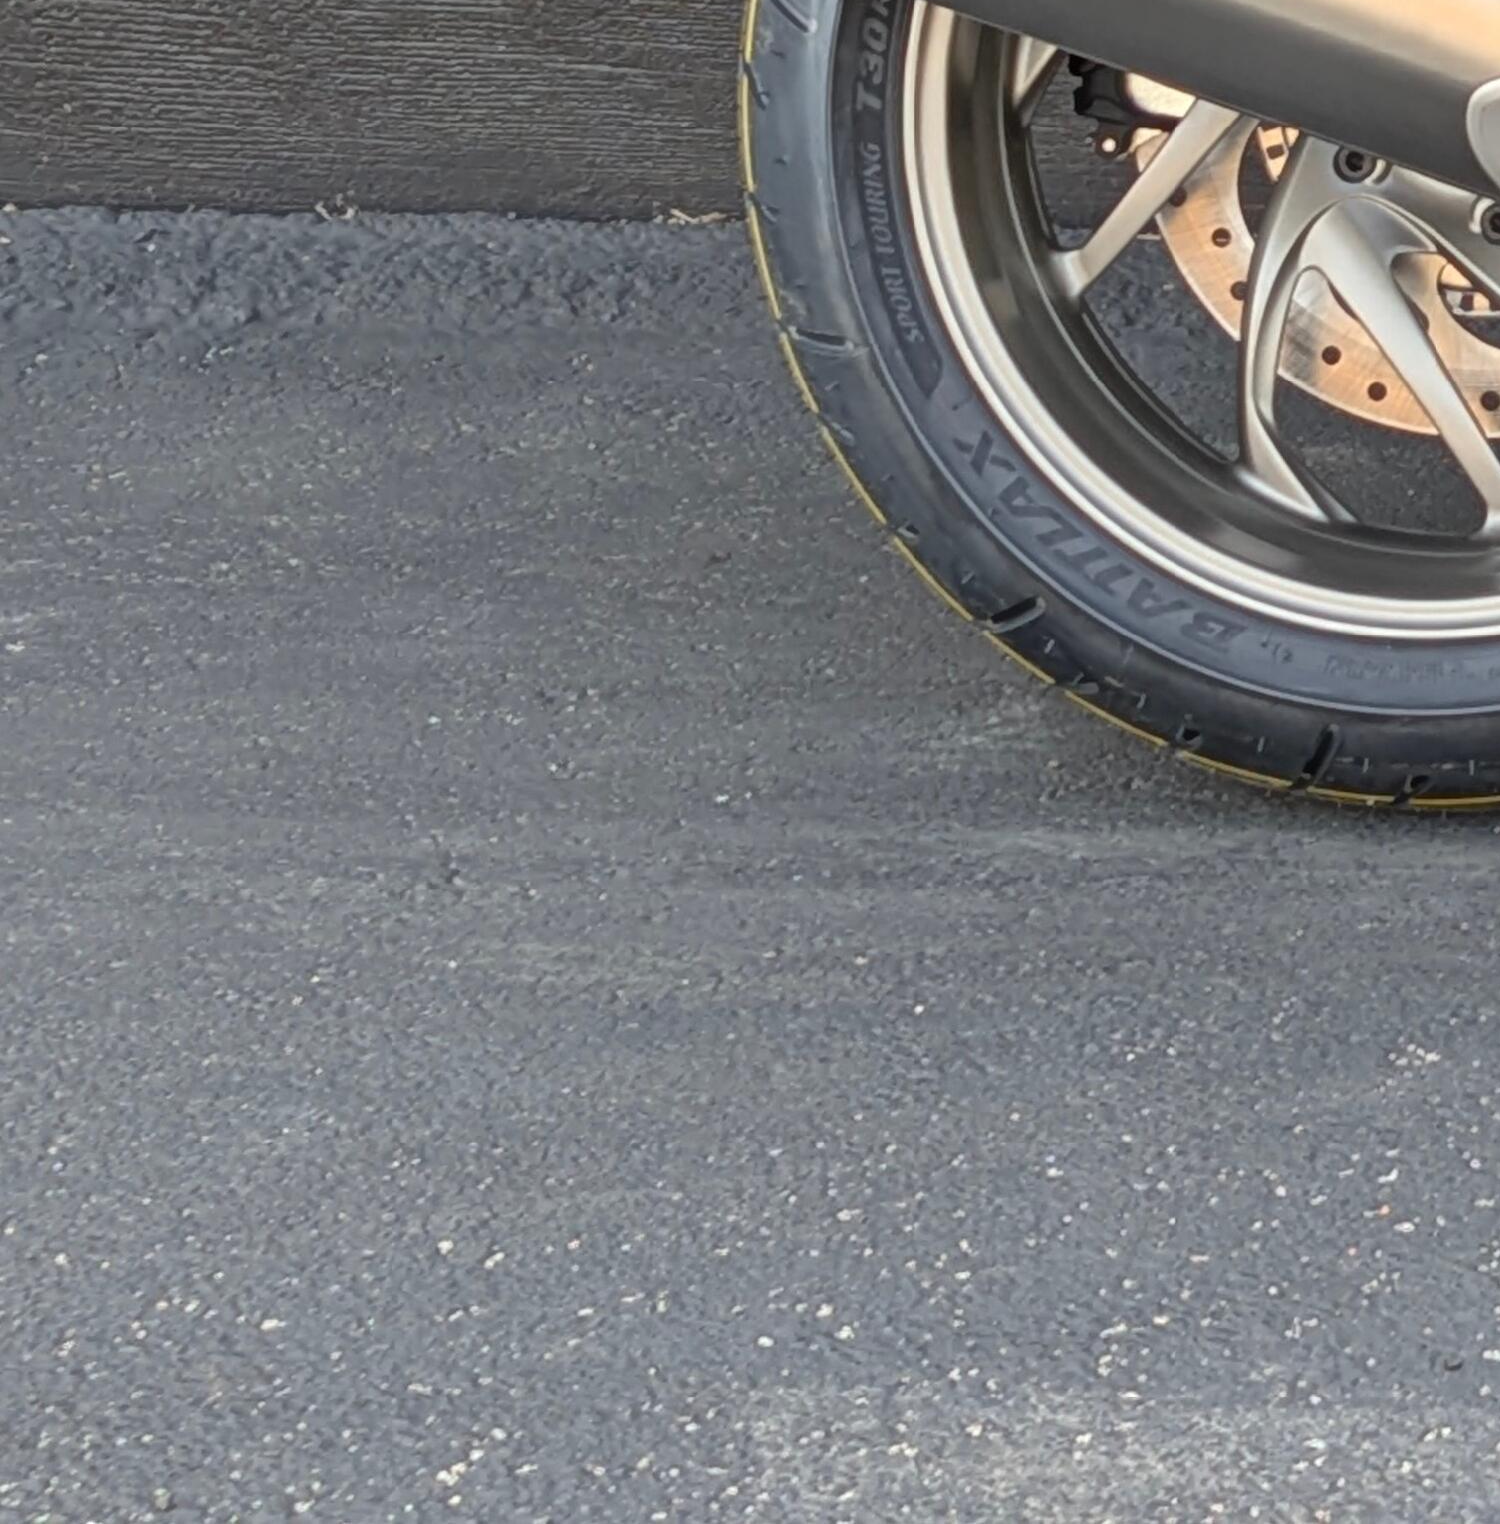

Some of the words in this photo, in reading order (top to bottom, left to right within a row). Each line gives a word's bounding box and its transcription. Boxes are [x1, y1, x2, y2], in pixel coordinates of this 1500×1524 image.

[860, 142, 894, 254] TOURING
[881, 266, 925, 344] SPORT
[953, 430, 1248, 654] BATTLAX
